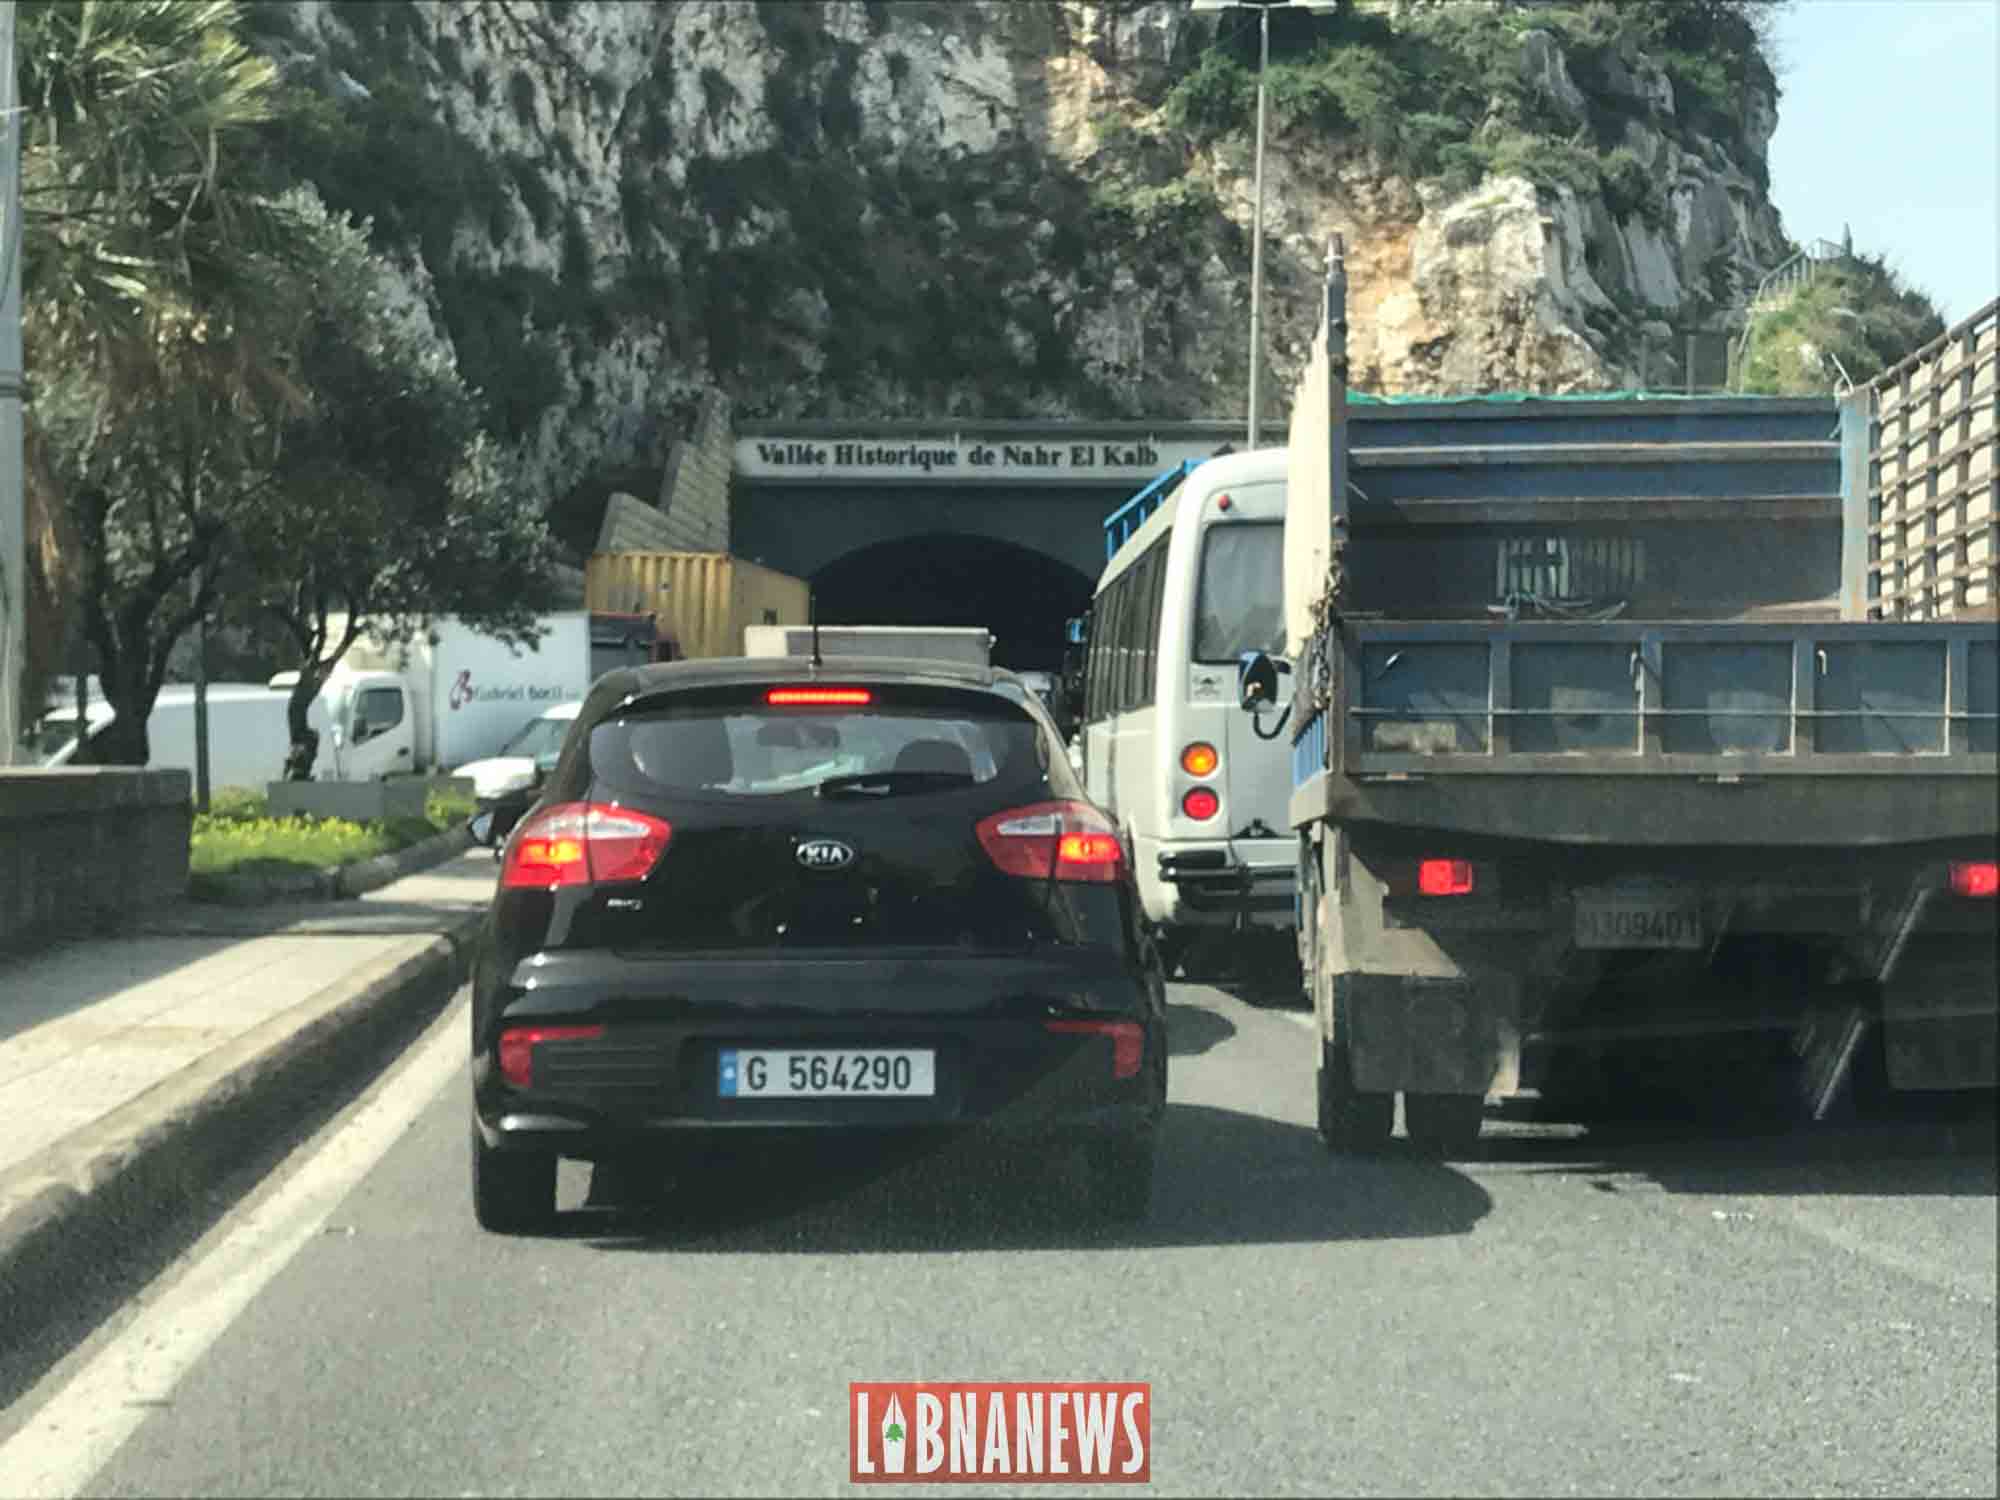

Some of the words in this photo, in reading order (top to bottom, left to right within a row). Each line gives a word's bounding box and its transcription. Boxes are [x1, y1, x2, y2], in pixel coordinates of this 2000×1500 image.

[757, 443, 827, 465] Vallée
[834, 443, 958, 471] Historique
[968, 445, 996, 465] de
[1003, 445, 1063, 466] Nahr
[1070, 446, 1096, 465] El
[1103, 443, 1159, 466] Kalb
[746, 1055, 768, 1092] G
[788, 1055, 912, 1092] 564290
